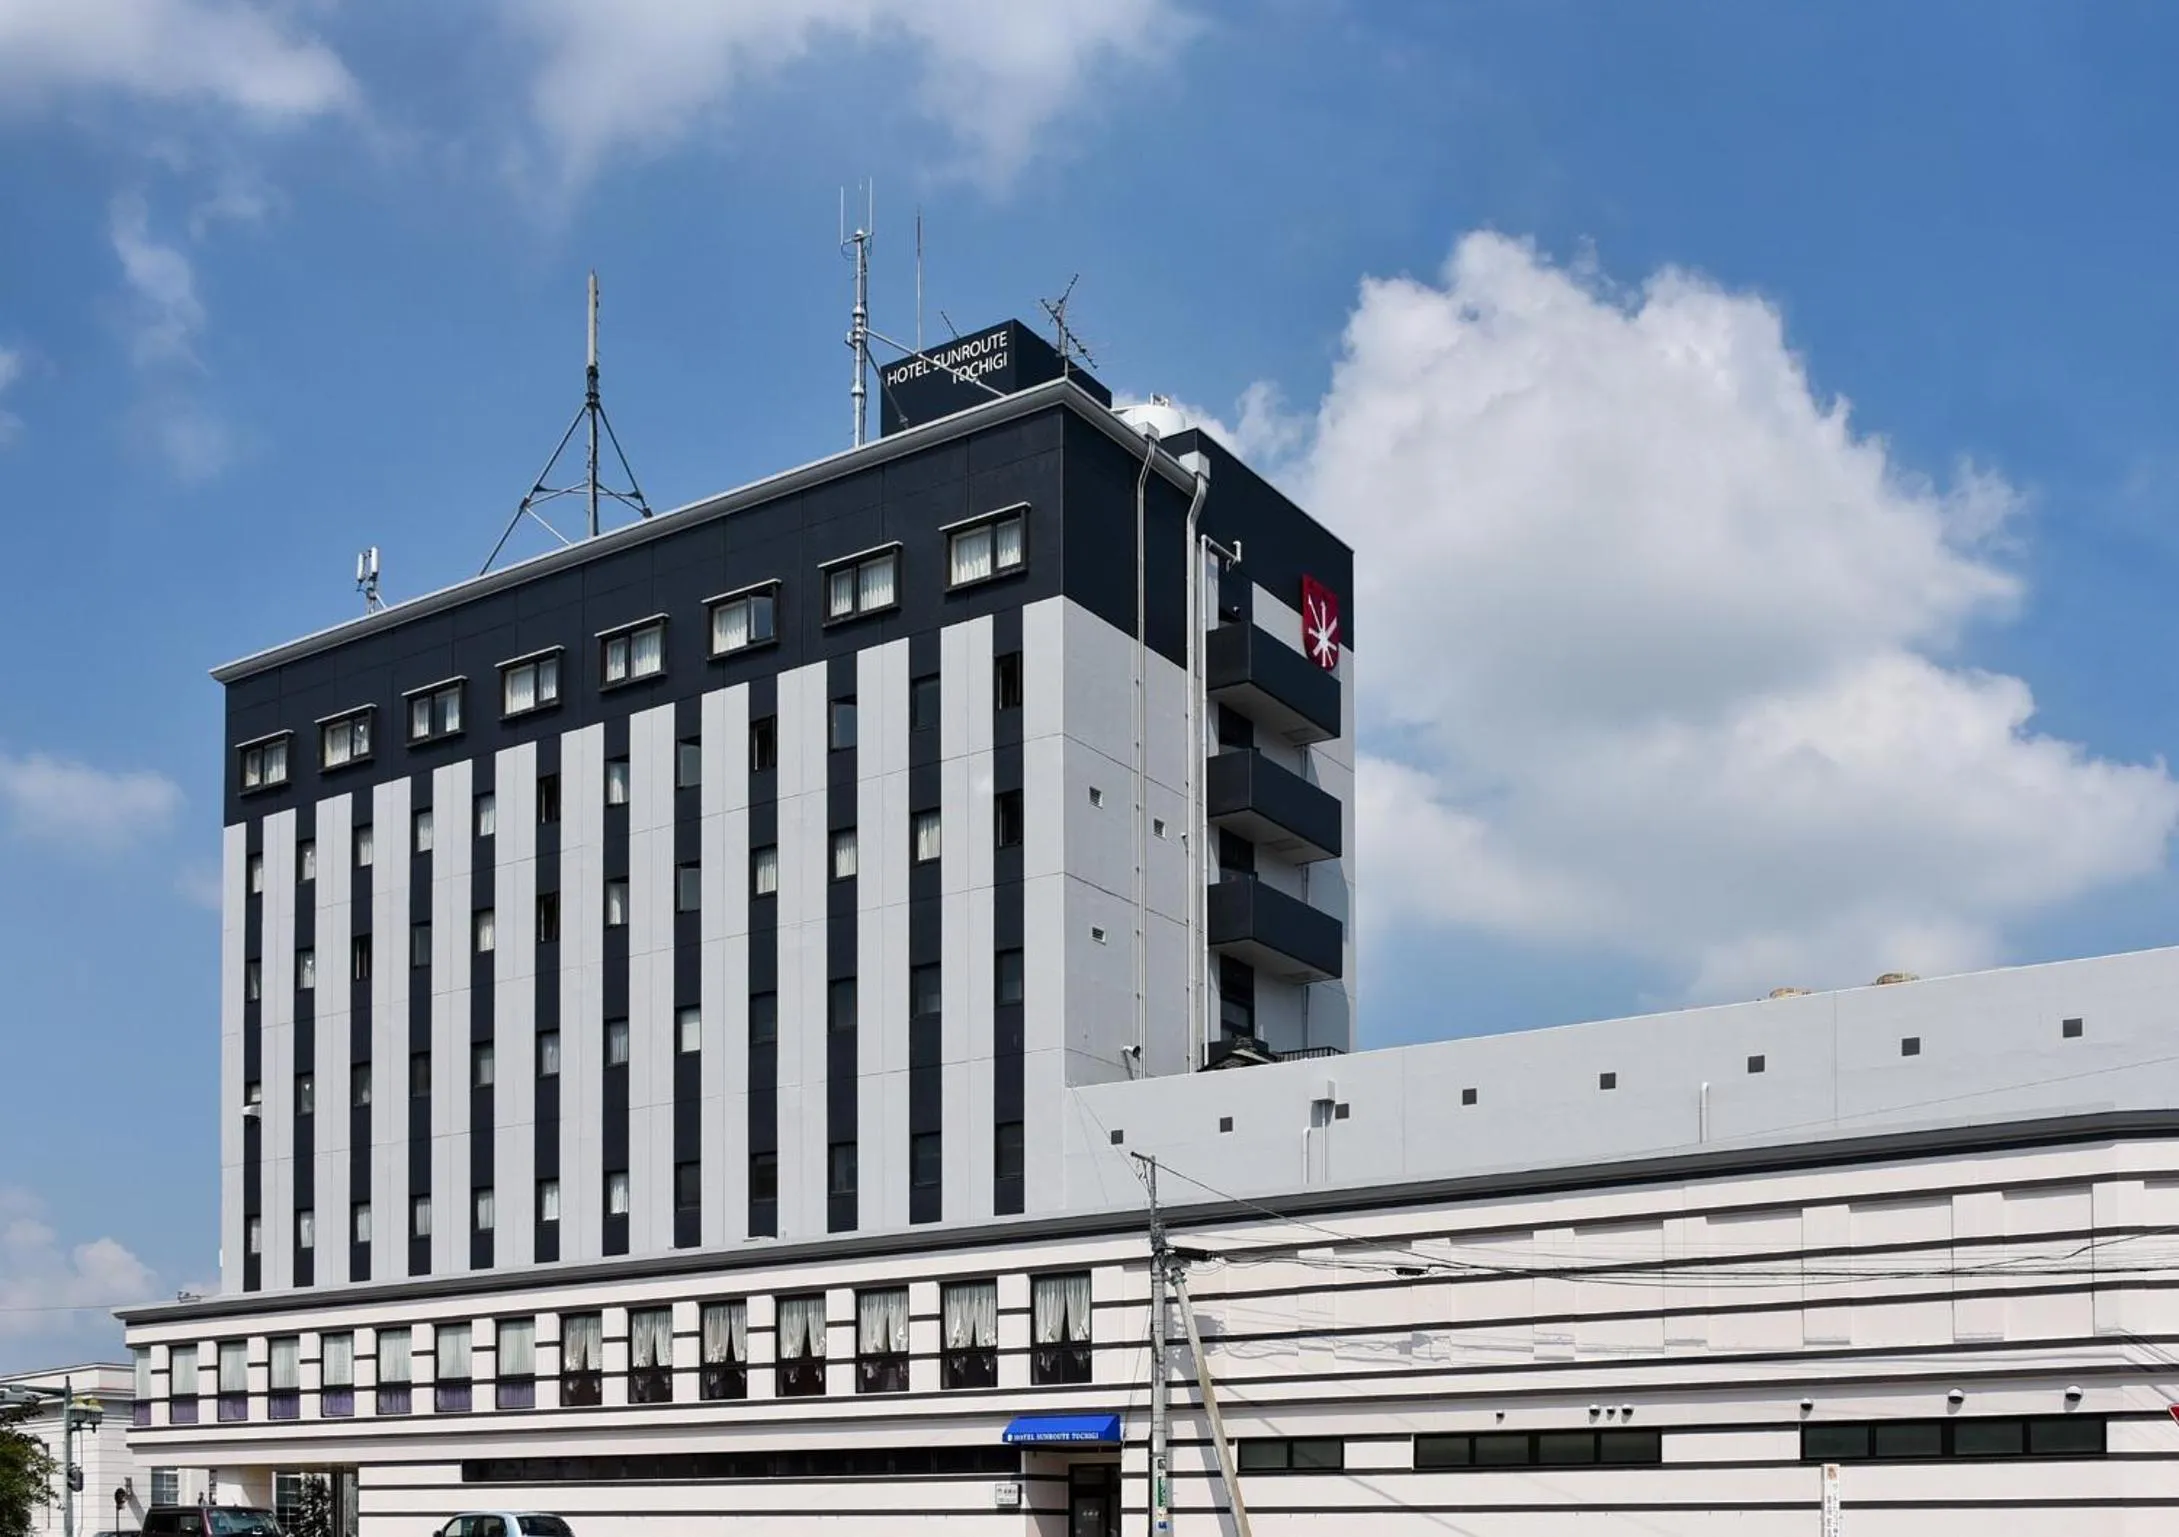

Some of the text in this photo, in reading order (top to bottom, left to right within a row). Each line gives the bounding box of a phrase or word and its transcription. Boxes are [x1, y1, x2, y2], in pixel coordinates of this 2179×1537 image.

[887, 330, 1008, 387] HOTEL SUNROUTE
[952, 351, 1008, 384] TOCHIGI
